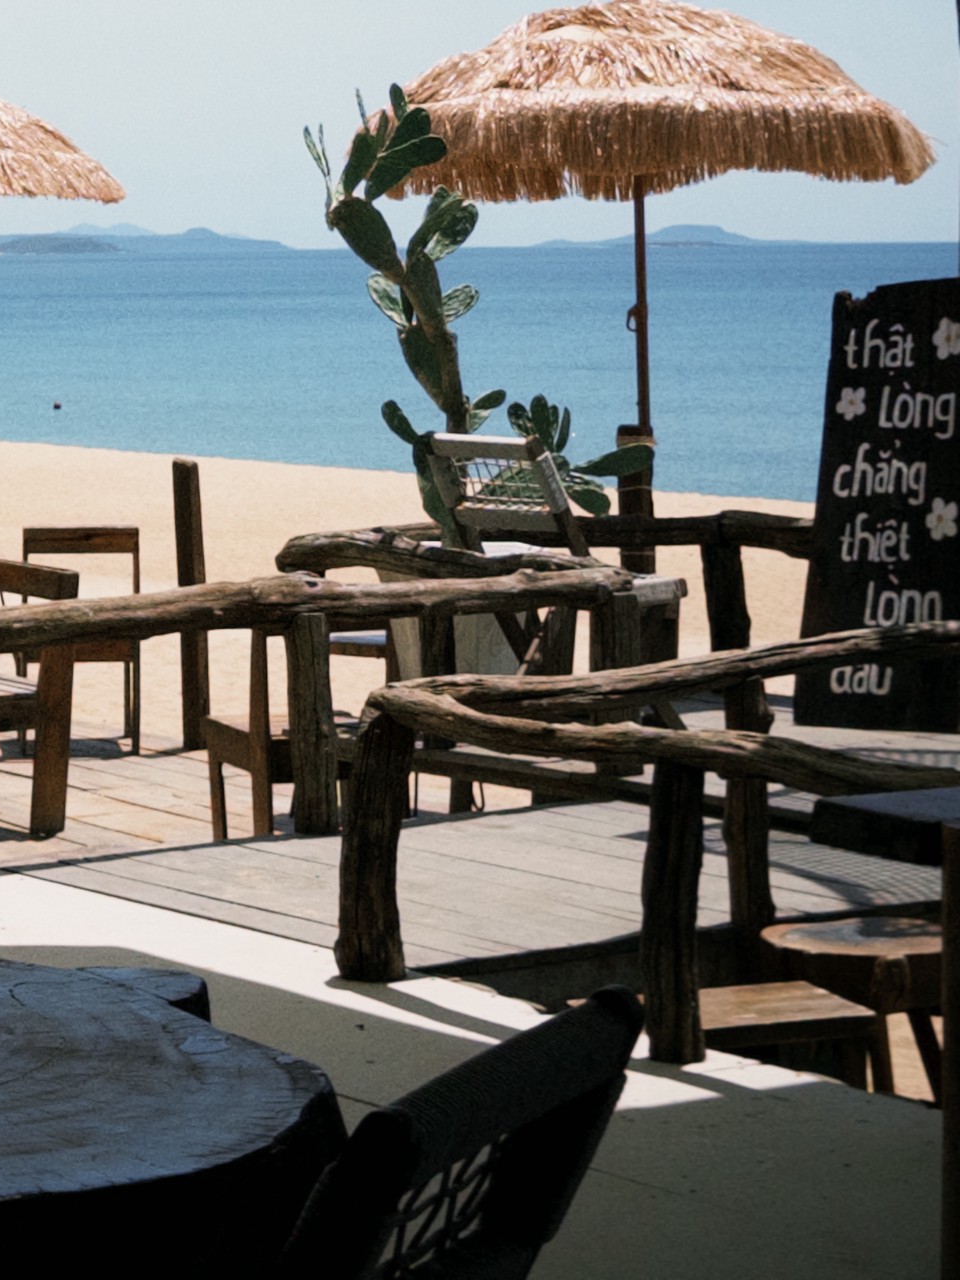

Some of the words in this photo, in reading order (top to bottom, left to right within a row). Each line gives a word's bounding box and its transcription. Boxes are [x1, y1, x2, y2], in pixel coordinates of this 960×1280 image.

[843, 318, 915, 376] thật
[832, 439, 927, 506] chẳng
[840, 512, 911, 569] thiệt
